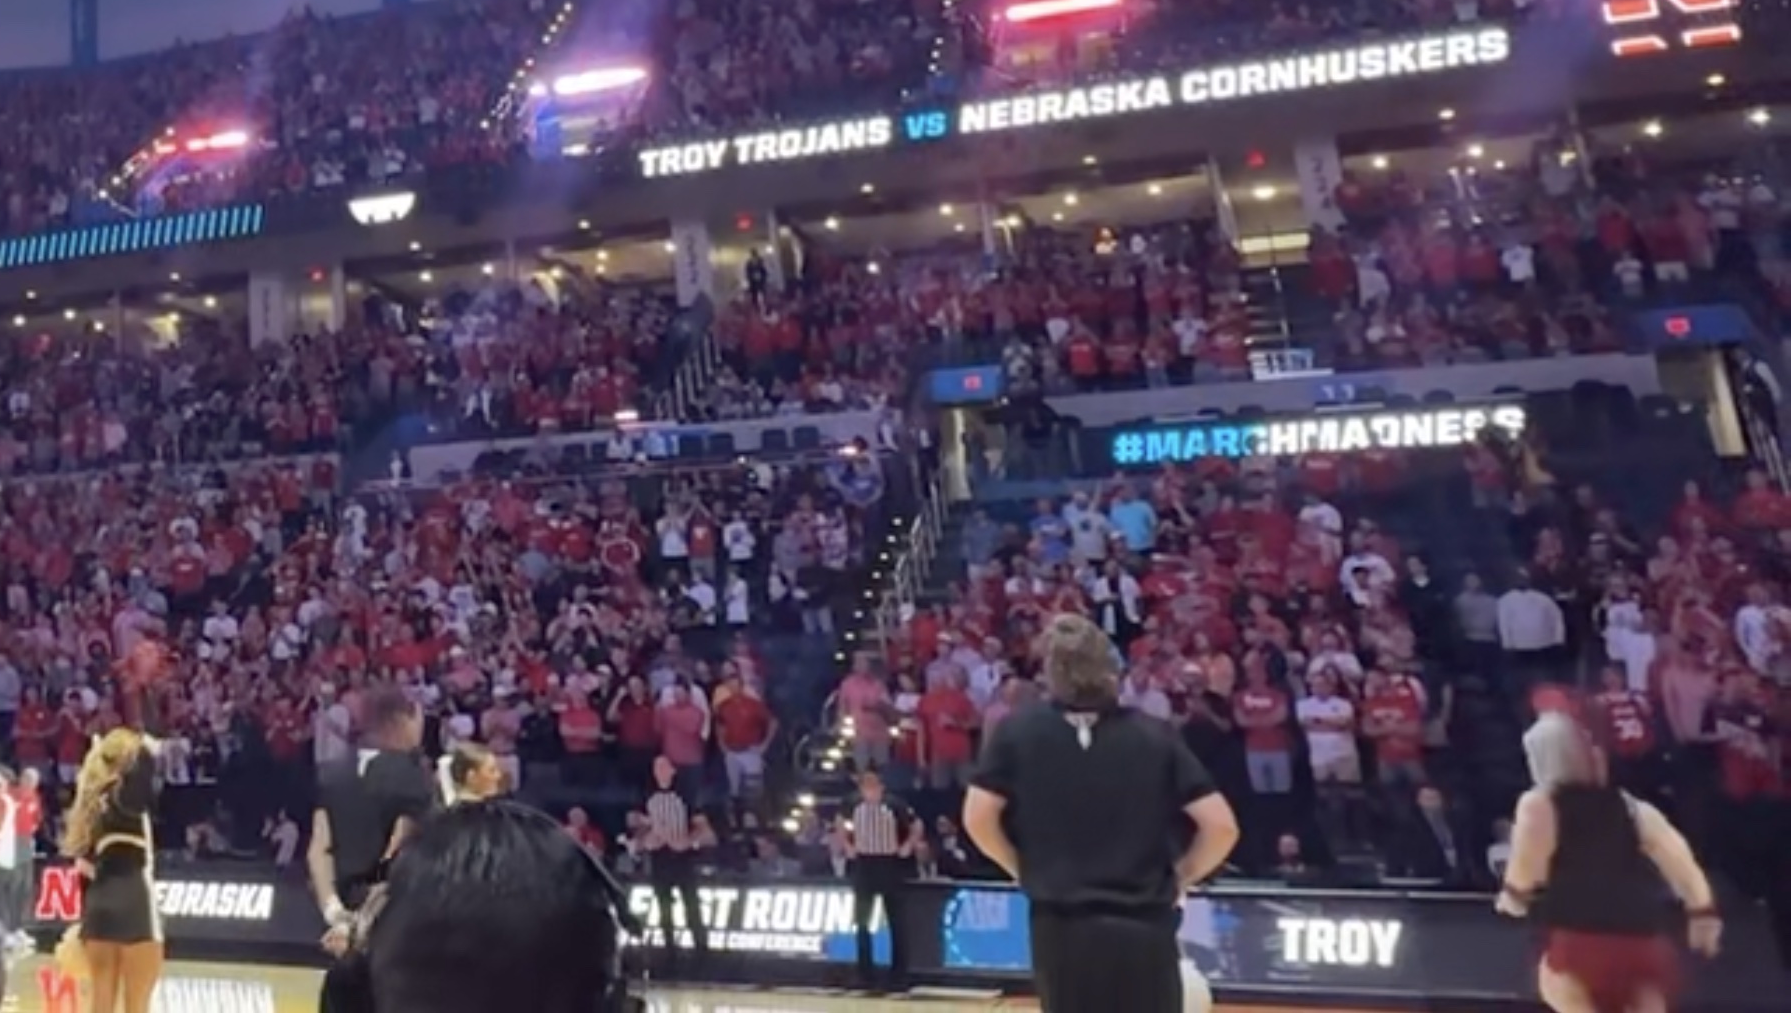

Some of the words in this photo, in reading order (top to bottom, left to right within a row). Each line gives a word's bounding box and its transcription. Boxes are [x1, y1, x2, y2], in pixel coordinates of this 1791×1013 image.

[639, 140, 727, 178] TROY
[734, 115, 893, 164] TROJANS
[906, 111, 947, 140] VS
[958, 78, 1172, 134] NEBRASKA
[1180, 27, 1509, 104] CORNHUSKERS
[35, 866, 83, 921] N
[154, 879, 275, 920] EBRASKA
[1275, 917, 1403, 967] TROY
